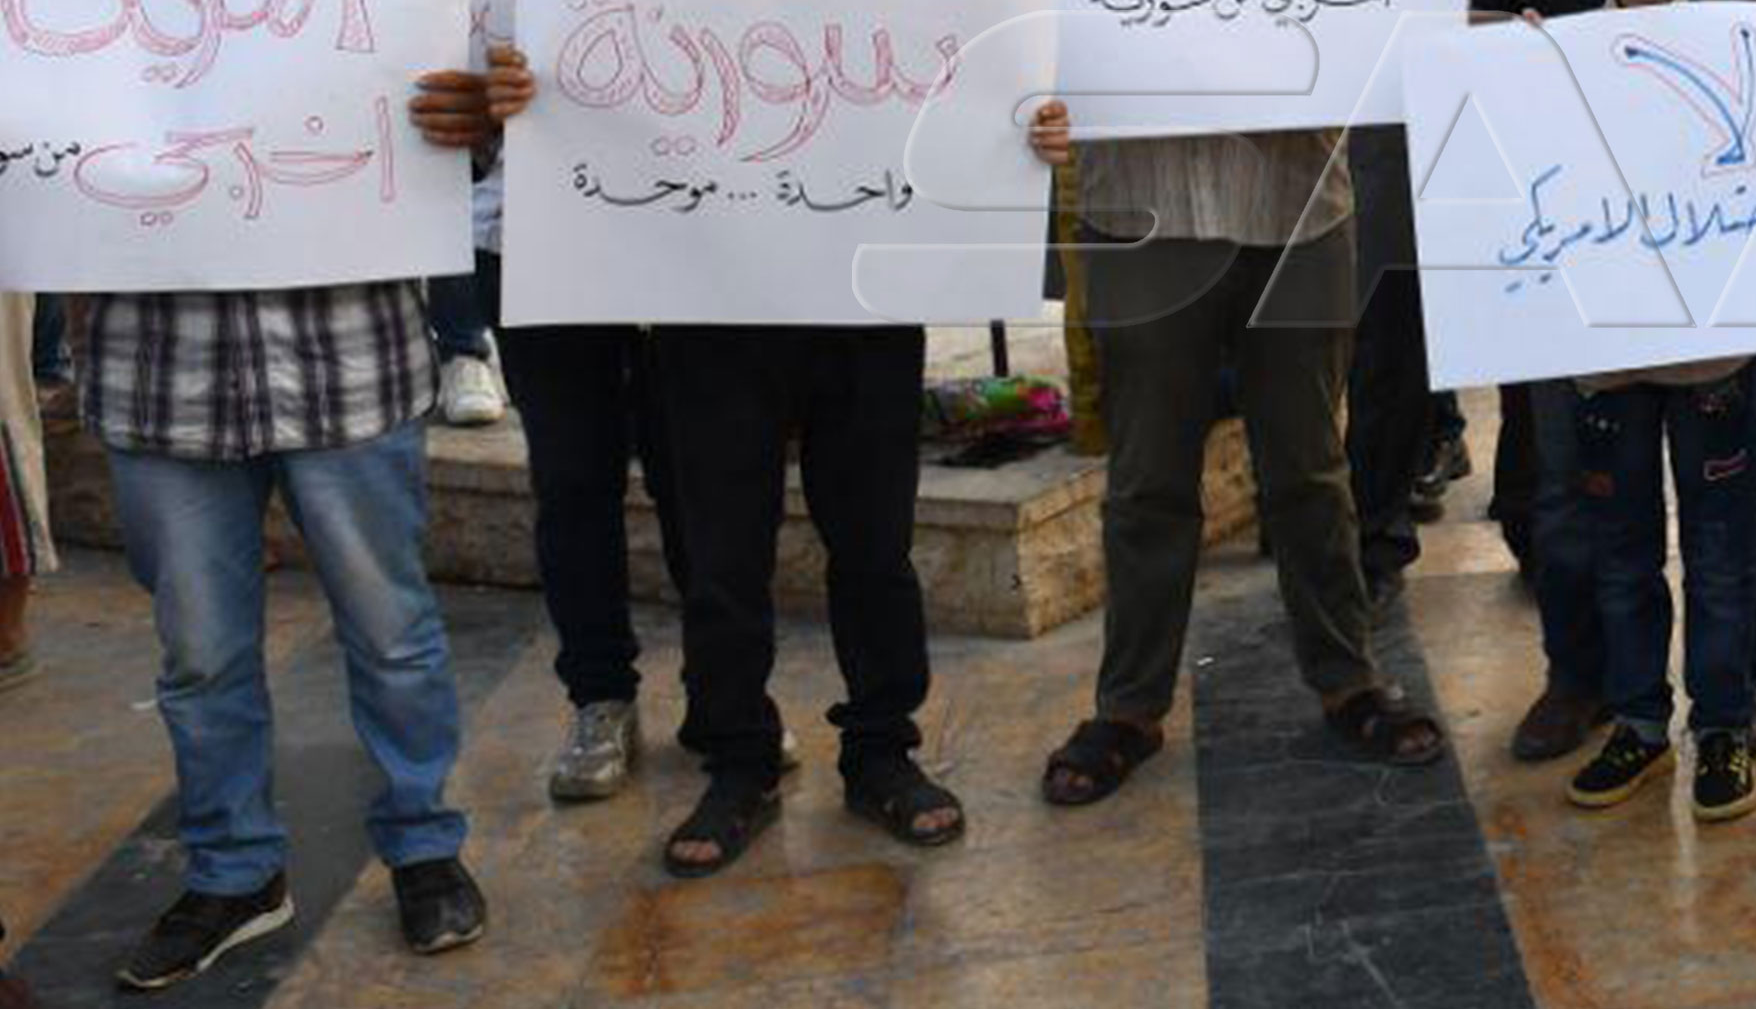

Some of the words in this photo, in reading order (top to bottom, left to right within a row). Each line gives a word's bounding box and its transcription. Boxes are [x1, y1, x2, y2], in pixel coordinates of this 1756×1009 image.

[34, 140, 81, 178] من
[75, 95, 395, 227] اخرجي
[573, 163, 718, 213] موحدة
[777, 169, 914, 212] واحدة
